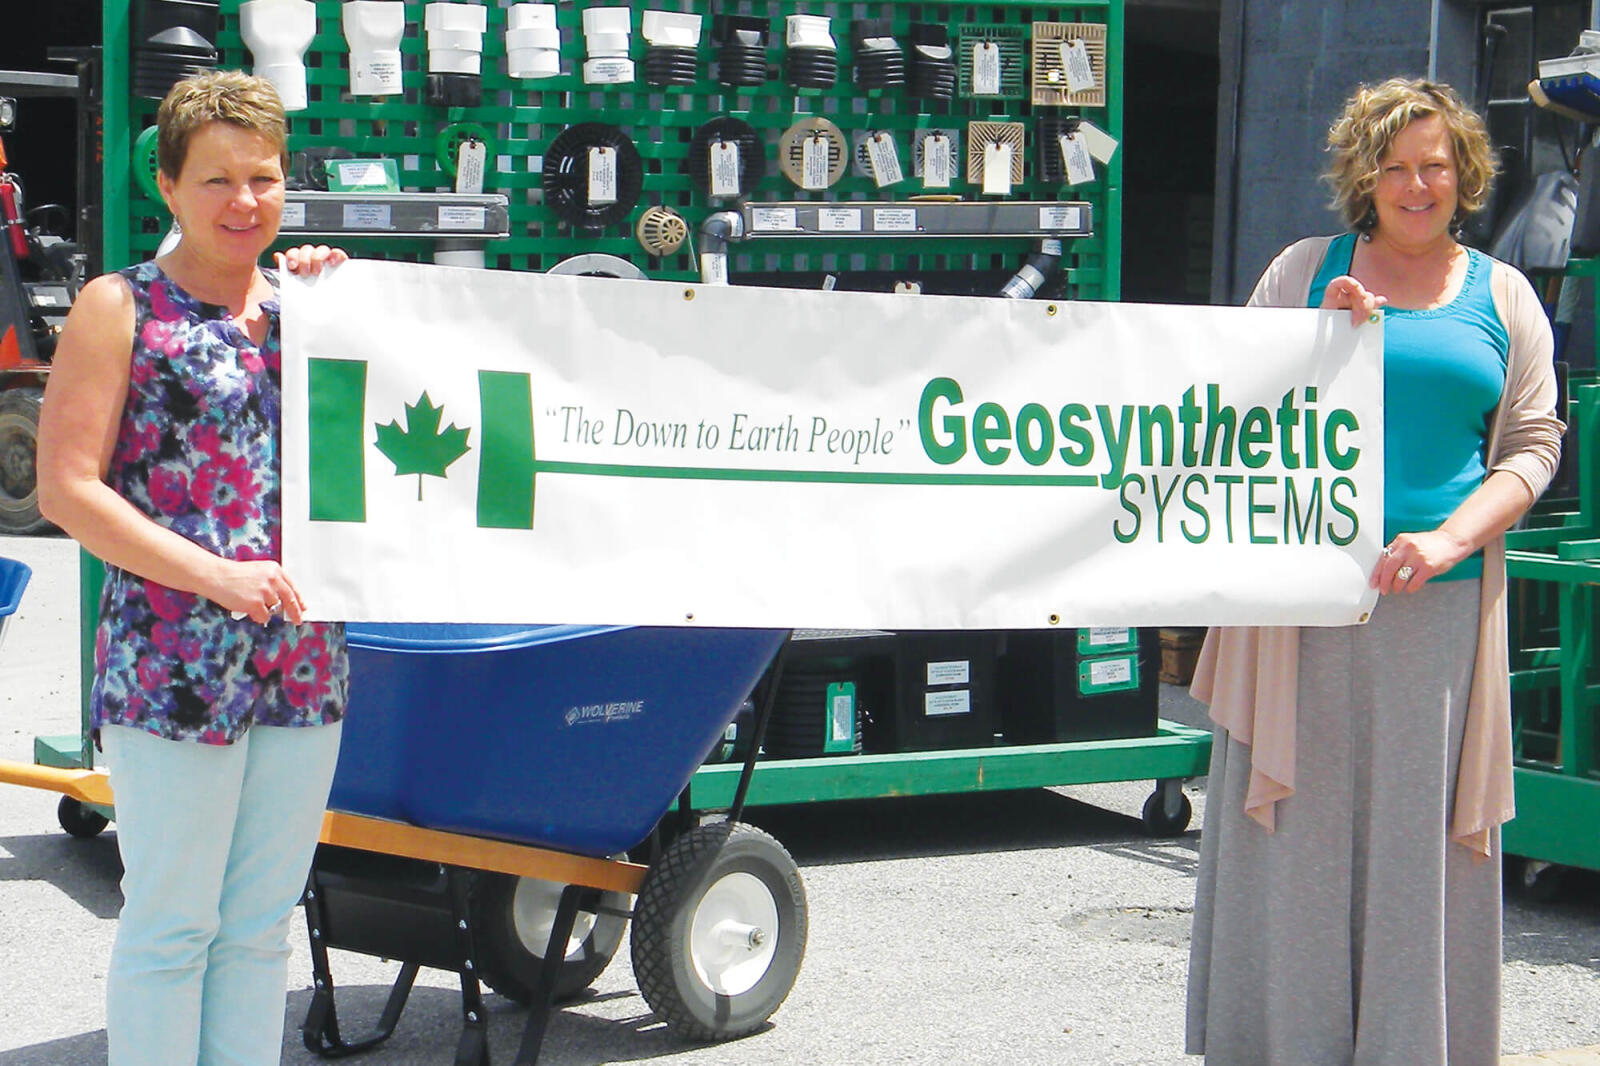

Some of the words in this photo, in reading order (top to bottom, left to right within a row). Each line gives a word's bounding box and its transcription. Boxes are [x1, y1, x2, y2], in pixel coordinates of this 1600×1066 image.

[613, 408, 688, 450] Down
[696, 420, 720, 450] to
[728, 412, 800, 454] Earth
[918, 376, 1361, 491] Geosynthetic
[1114, 472, 1360, 547] SYSTEMS
[581, 700, 645, 718] WOLVERINE
